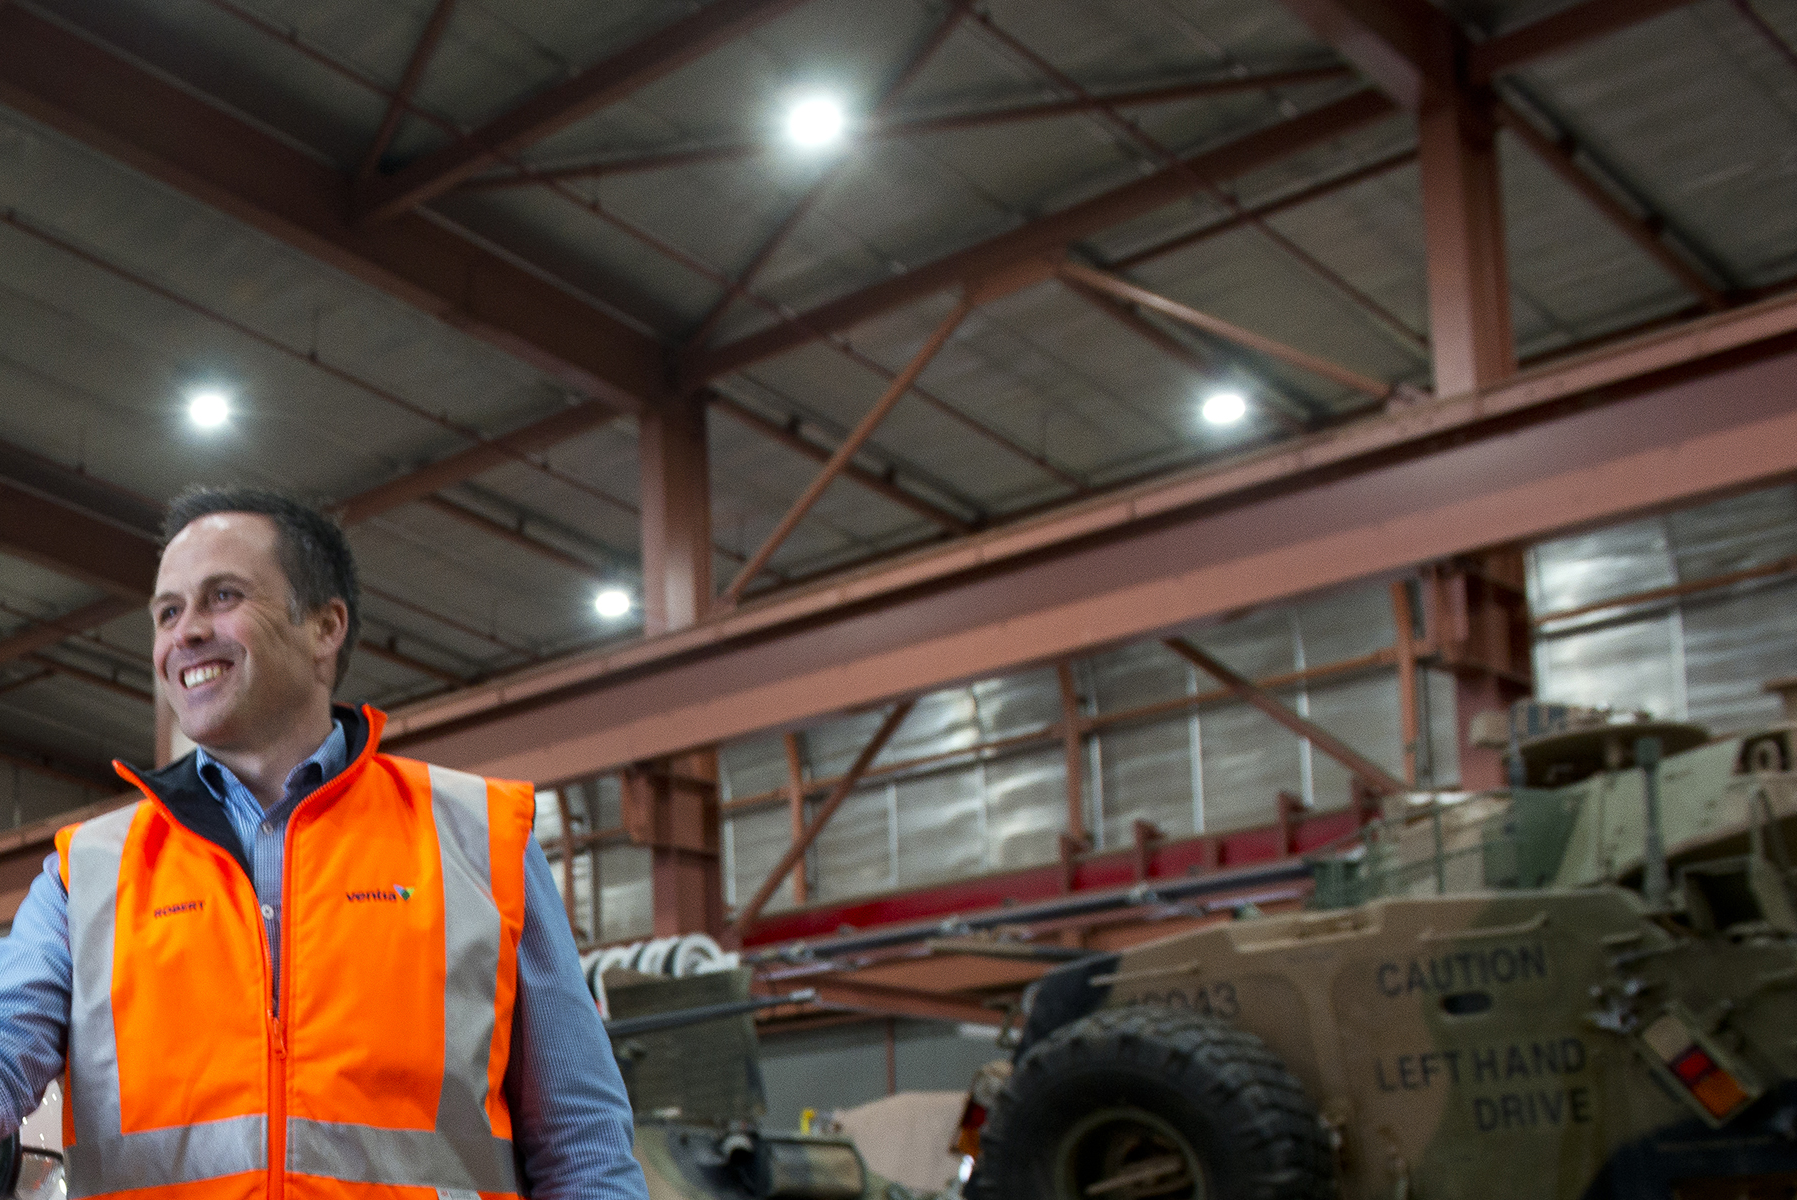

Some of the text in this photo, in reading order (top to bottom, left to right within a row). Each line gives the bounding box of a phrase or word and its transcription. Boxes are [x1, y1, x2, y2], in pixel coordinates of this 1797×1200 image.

[345, 889, 396, 902] ventia
[1377, 944, 1548, 998] CAUTION
[1373, 1037, 1587, 1092] LEFT HAND
[1473, 1085, 1592, 1132] DRIVE
